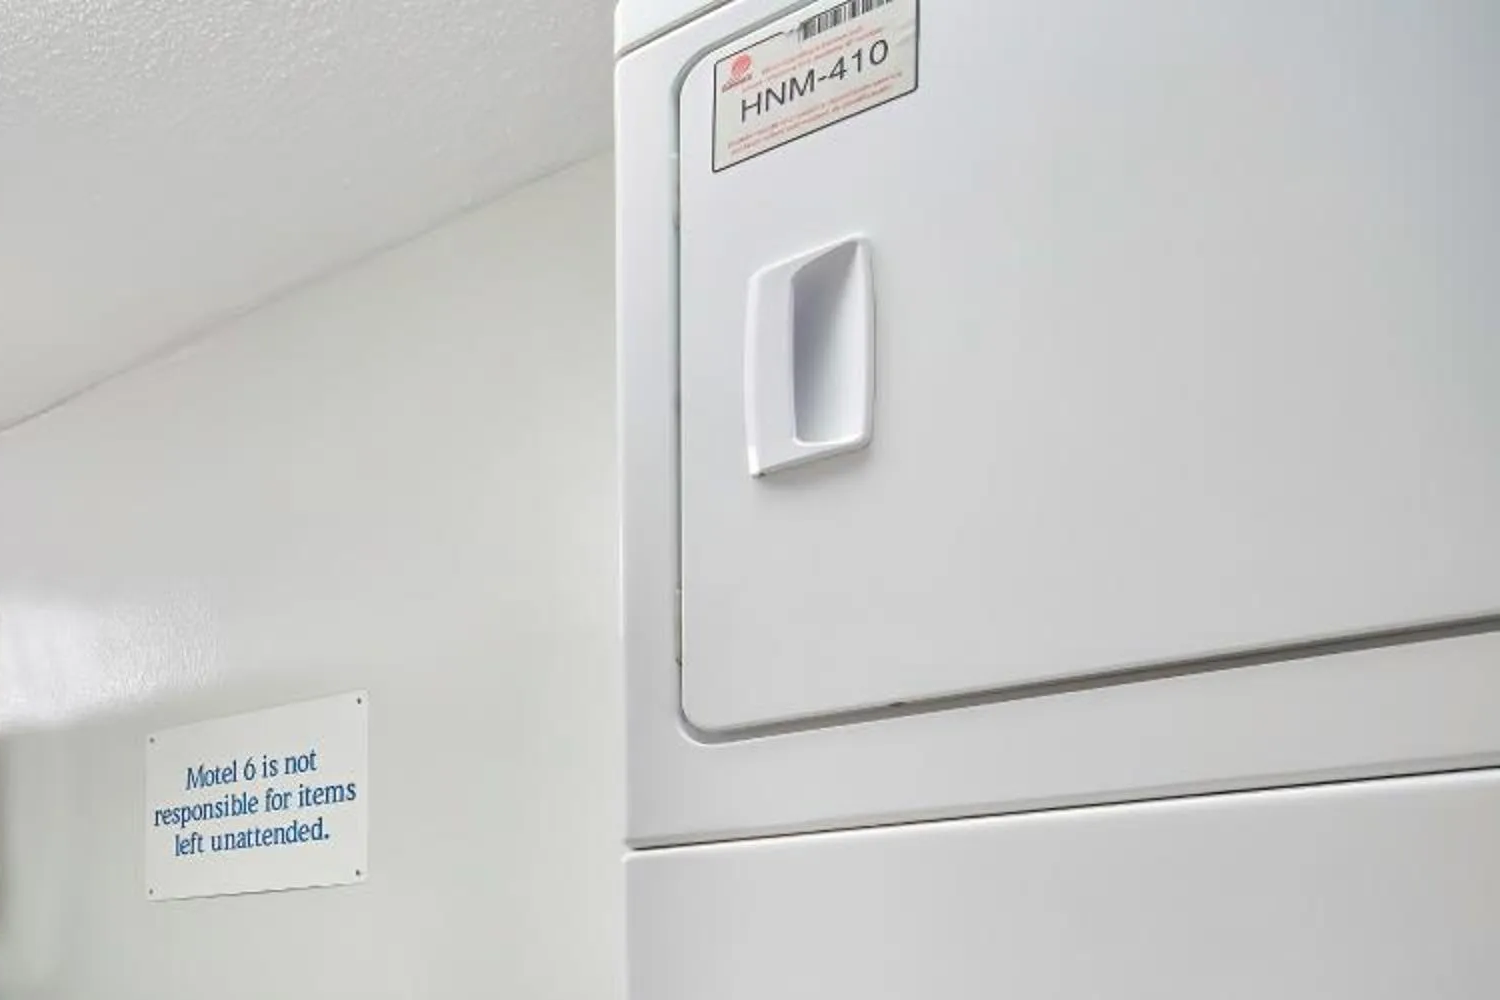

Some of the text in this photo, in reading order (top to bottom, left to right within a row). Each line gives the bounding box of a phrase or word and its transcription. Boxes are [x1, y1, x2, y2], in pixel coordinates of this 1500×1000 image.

[741, 39, 889, 123] HNM-410
[186, 749, 317, 790] Motel 6 is not
[154, 781, 357, 828] responsible for items
[175, 816, 330, 856] left unattended.
